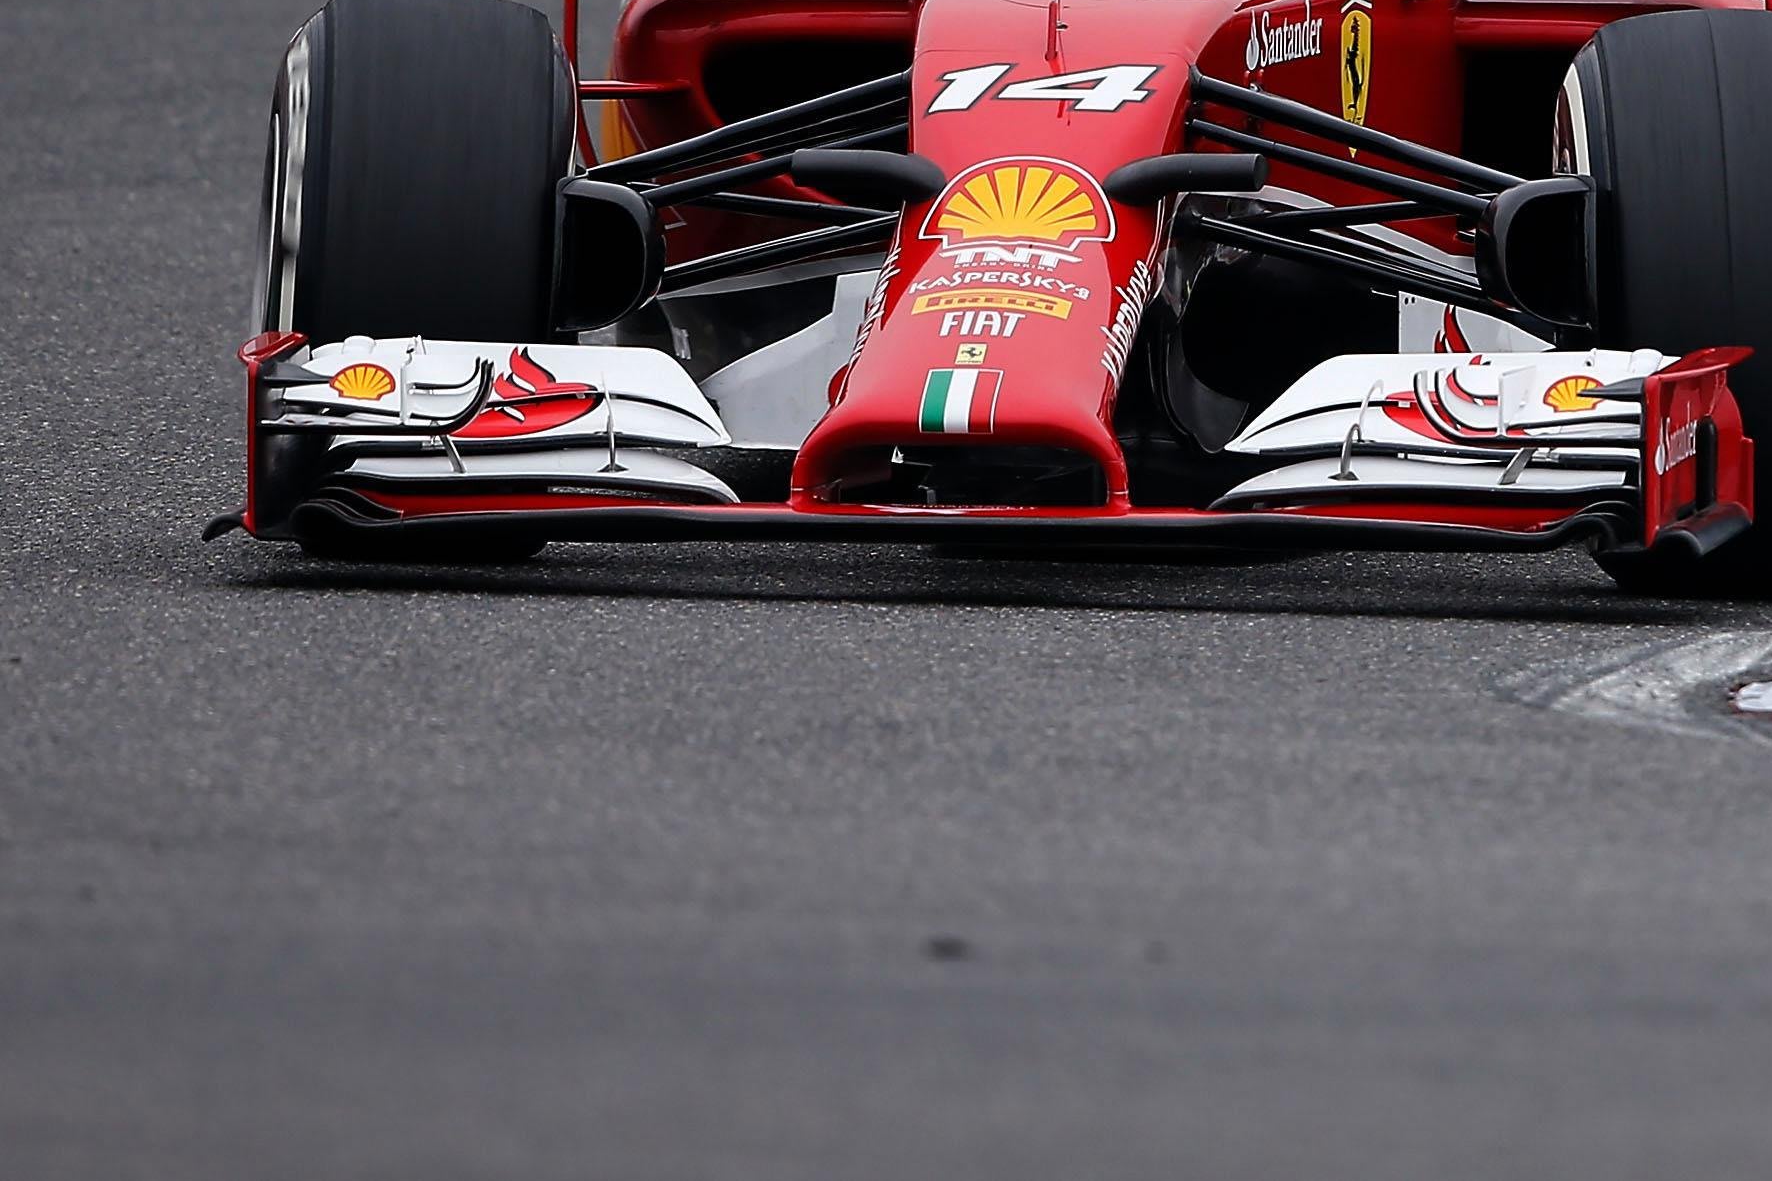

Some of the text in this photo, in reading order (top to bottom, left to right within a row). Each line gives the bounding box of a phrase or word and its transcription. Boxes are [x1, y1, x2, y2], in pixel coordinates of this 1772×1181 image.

[925, 63, 1161, 115] 14
[938, 246, 1083, 268] TNT
[908, 271, 1077, 295] KASPERSKY
[939, 310, 1026, 337] FIAT
